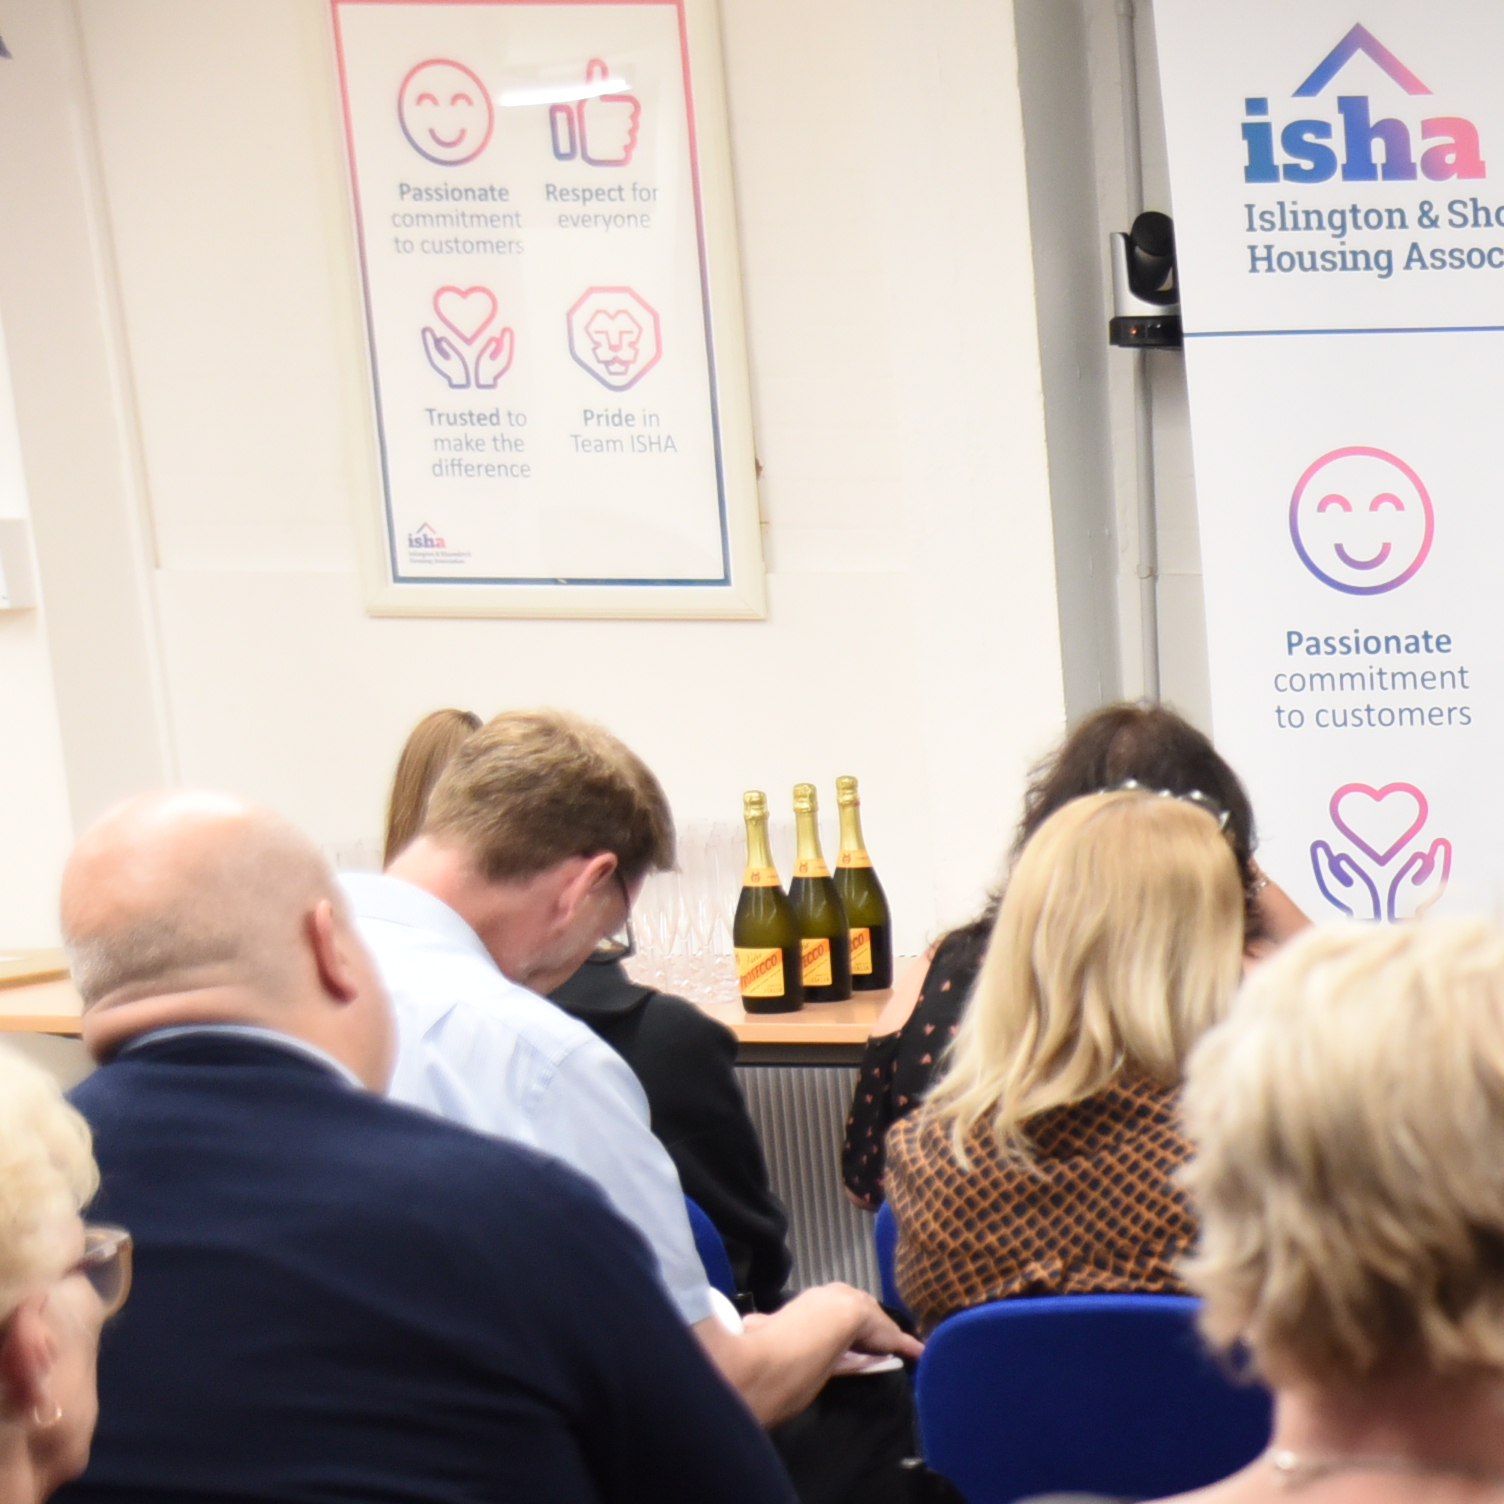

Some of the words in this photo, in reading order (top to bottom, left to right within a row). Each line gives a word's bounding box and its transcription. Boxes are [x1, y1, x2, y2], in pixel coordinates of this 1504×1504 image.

[1241, 95, 1487, 184] isha
[399, 182, 510, 202] Passionate
[545, 183, 625, 205] Respect
[631, 182, 659, 201] for
[391, 210, 522, 228] commitment
[558, 213, 651, 232] everyone
[1244, 200, 1408, 238] Islington
[1417, 201, 1440, 229] &
[394, 237, 414, 254] to
[421, 238, 525, 255] customers
[1247, 241, 1394, 279] Housing
[425, 408, 501, 427] Trusted
[507, 410, 527, 427] to
[583, 409, 636, 427] Pride
[643, 409, 660, 427] in
[434, 434, 486, 452] make
[492, 433, 525, 452] the
[571, 434, 624, 453] Team
[631, 434, 678, 453] ISHA
[431, 458, 531, 478] difference
[408, 532, 446, 549] isha
[1286, 629, 1452, 656] Passionate
[1274, 665, 1470, 692] commitment
[1275, 705, 1305, 728] to
[1315, 703, 1472, 728] customers
